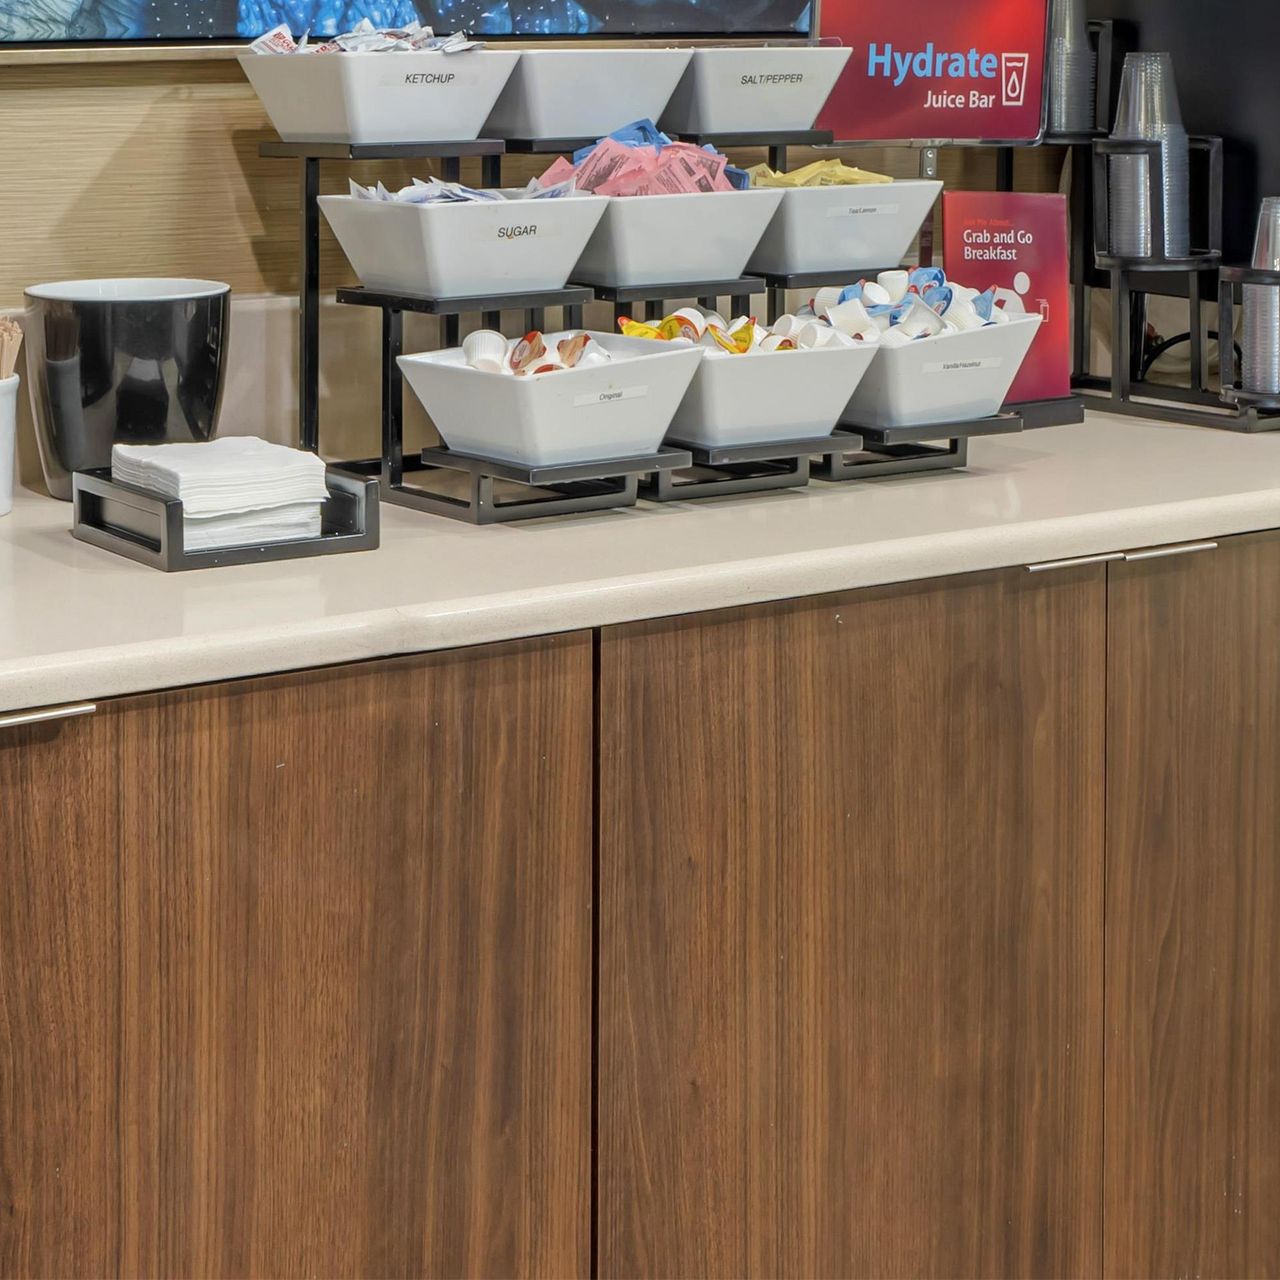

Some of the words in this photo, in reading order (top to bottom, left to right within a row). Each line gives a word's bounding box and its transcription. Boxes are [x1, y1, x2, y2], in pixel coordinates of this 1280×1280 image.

[867, 42, 999, 87] Hydrate
[404, 73, 456, 84] KETCHUP
[740, 73, 804, 85] SALT/PEPPER
[923, 90, 965, 108] Juice
[969, 90, 996, 108] Bar
[497, 224, 538, 238] SUGAR
[963, 229, 991, 244] Grab
[993, 230, 1015, 244] and
[1017, 230, 1033, 244] Go
[964, 245, 1017, 260] Breakfast
